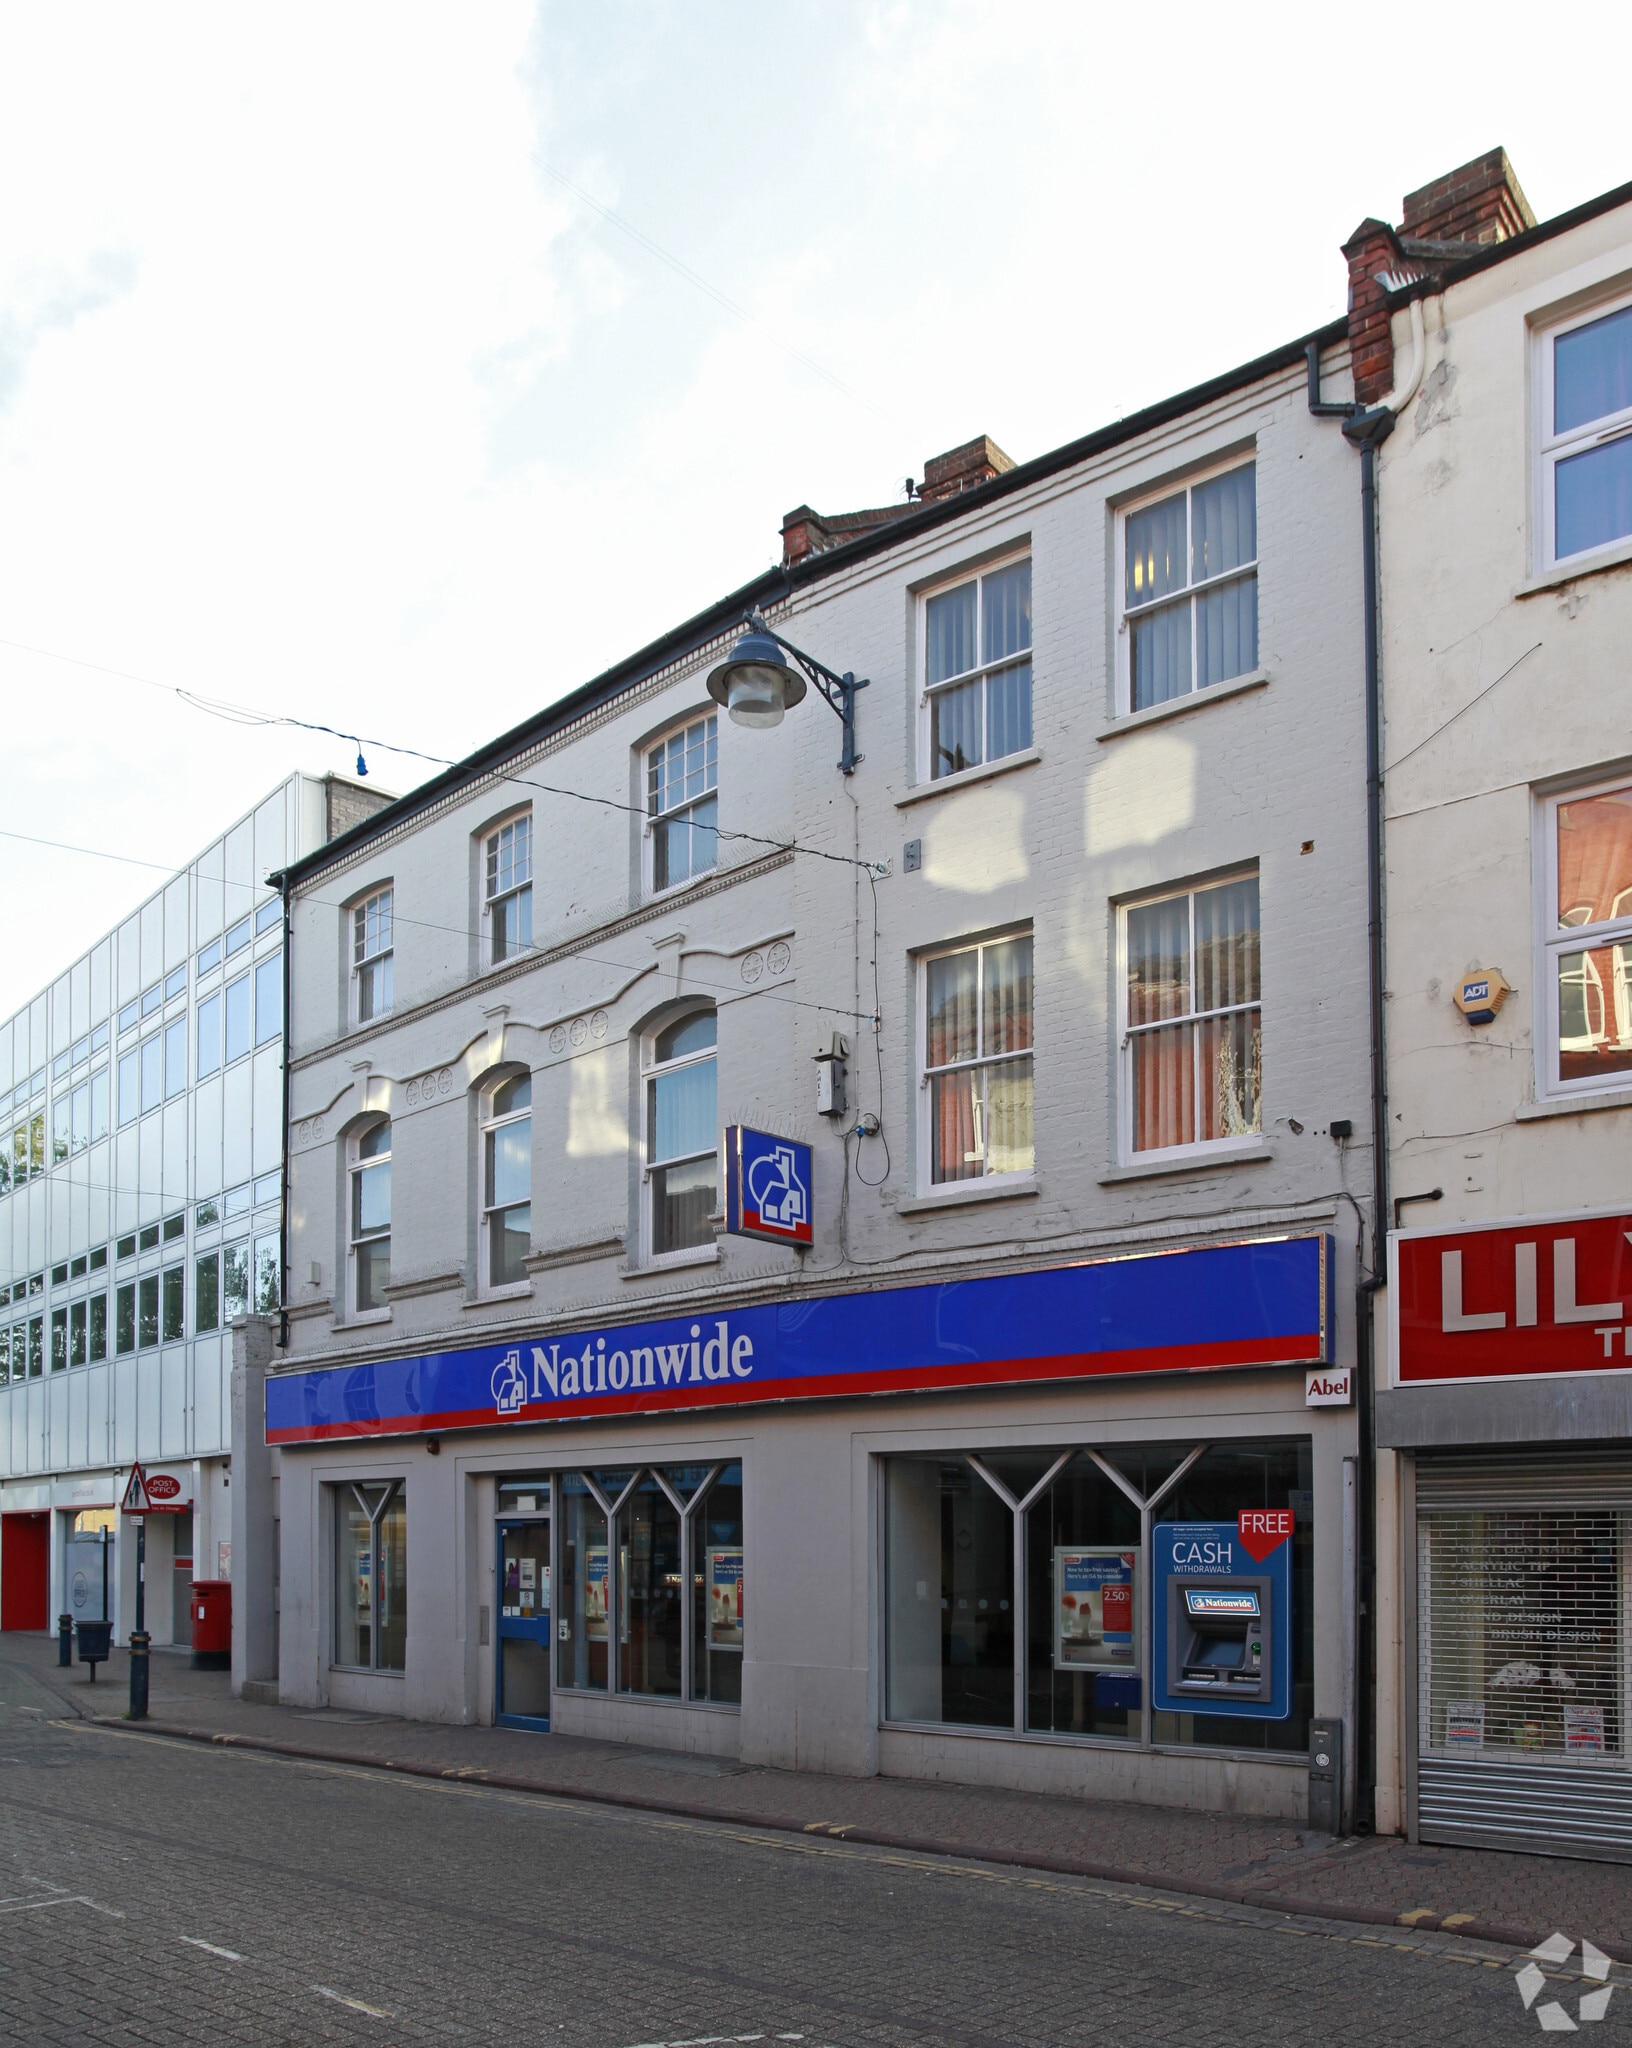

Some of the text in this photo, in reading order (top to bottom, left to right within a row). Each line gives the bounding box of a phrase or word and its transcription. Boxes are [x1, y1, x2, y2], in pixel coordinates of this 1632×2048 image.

[1464, 984, 1489, 999] ADT
[1442, 1231, 1632, 1333] LIL
[530, 1320, 754, 1398] Nationwide
[1308, 1377, 1348, 1396] Abel
[148, 1486, 177, 1494] OFFICE
[1241, 1513, 1290, 1533] FREE
[1172, 1542, 1232, 1564] CASH
[1173, 1564, 1232, 1574] WITHDRAWALS
[1459, 1560, 1550, 1571] ACRYLIC TIP
[1459, 1577, 1525, 1588] SHELLAC
[1204, 1598, 1252, 1608] Nationwide
[1459, 1594, 1526, 1605] OVERLAY
[1459, 1611, 1562, 1624] HAND DESIGN
[1490, 1629, 1541, 1641] BRUSH
[1546, 1630, 1602, 1642] DESIGN
